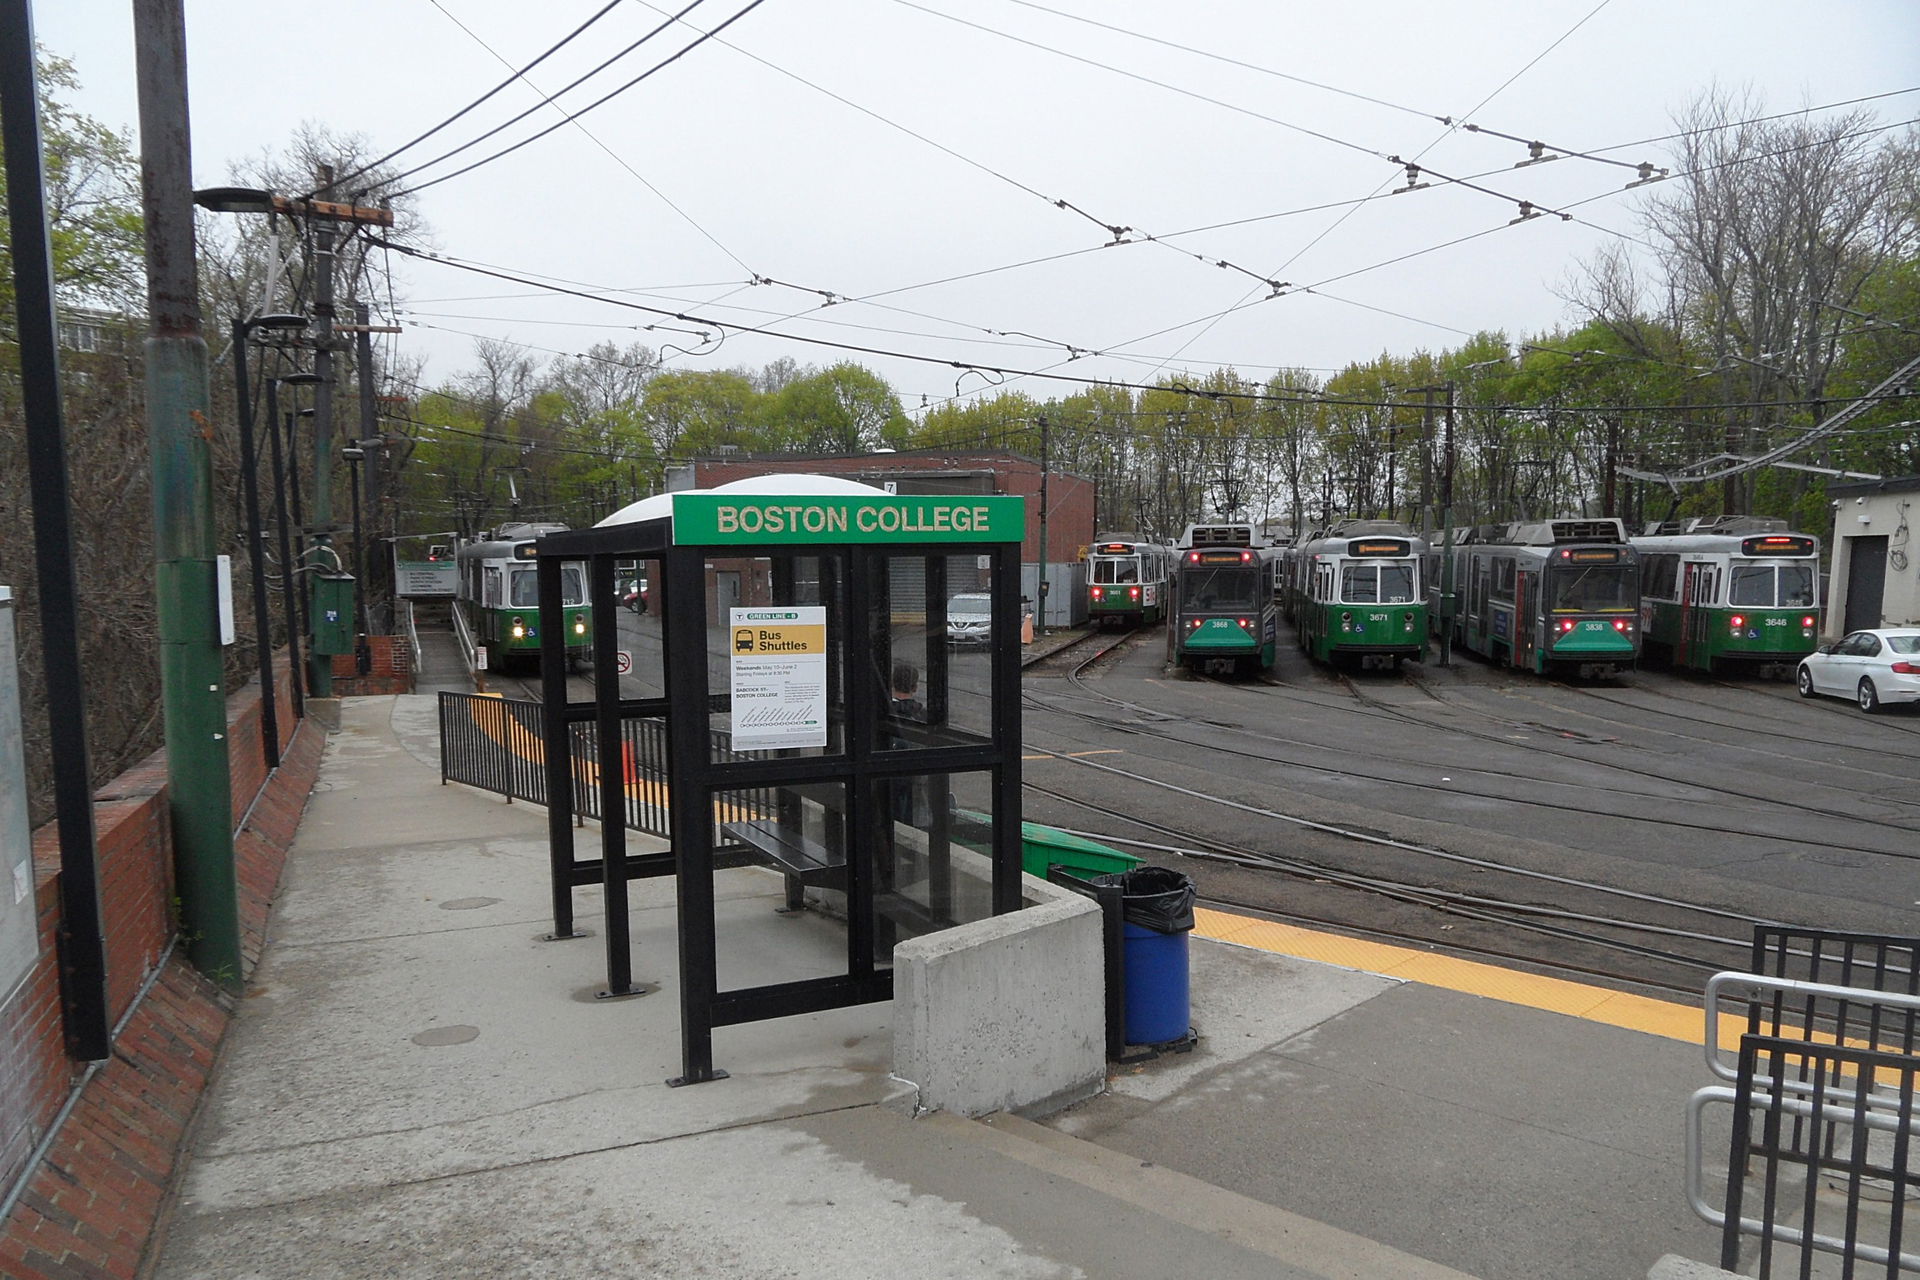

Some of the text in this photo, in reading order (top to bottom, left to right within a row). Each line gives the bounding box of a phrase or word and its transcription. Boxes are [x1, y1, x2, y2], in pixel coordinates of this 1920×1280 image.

[888, 484, 893, 493] 7
[717, 505, 990, 533] BOSTON COLLEGE
[1369, 613, 1388, 621] 3671
[1765, 618, 1787, 626] 3646
[759, 630, 782, 640] Bus
[759, 641, 808, 651] Shuttles
